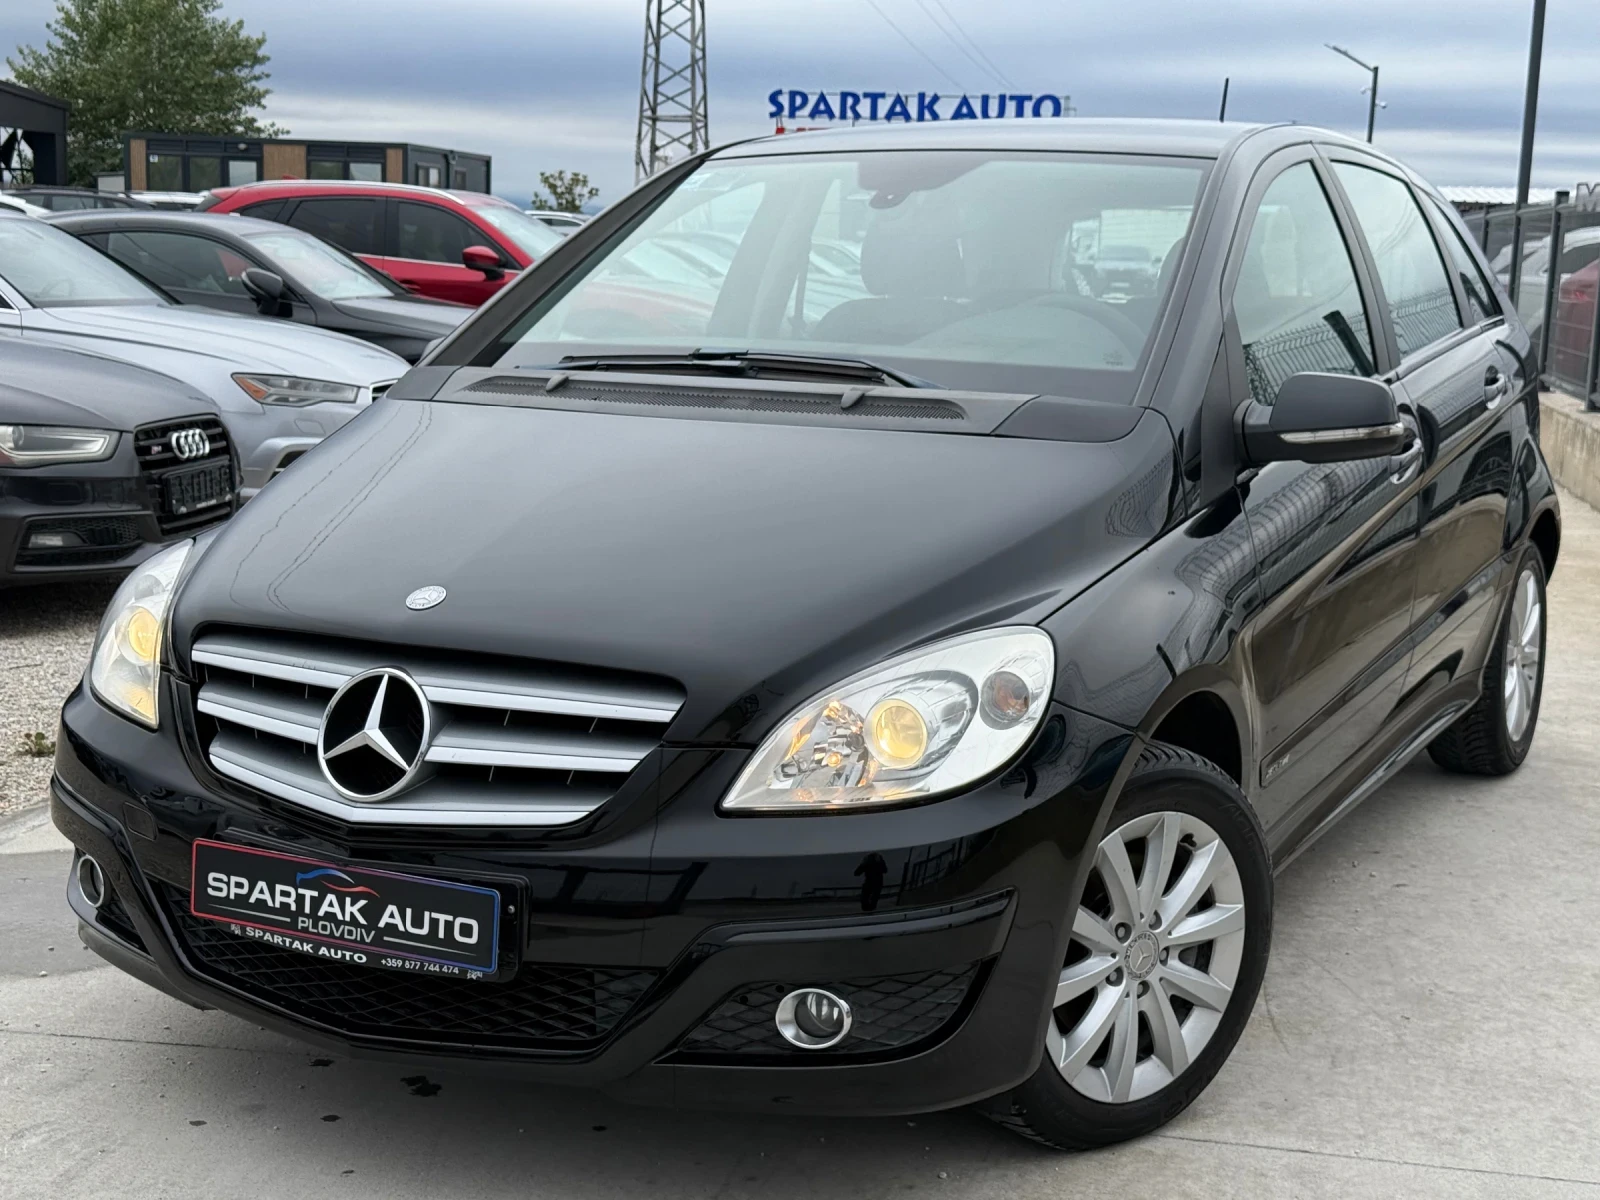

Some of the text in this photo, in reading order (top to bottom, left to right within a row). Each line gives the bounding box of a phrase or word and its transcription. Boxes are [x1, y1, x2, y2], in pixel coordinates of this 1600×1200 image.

[768, 89, 1062, 122] SPARTAK AUTO
[207, 872, 479, 944] SPARTAK AUTO
[246, 926, 367, 964] SPARTAK AUTO
[298, 916, 376, 943] PLOVDIV
[380, 957, 460, 975] +359 877 744 474
